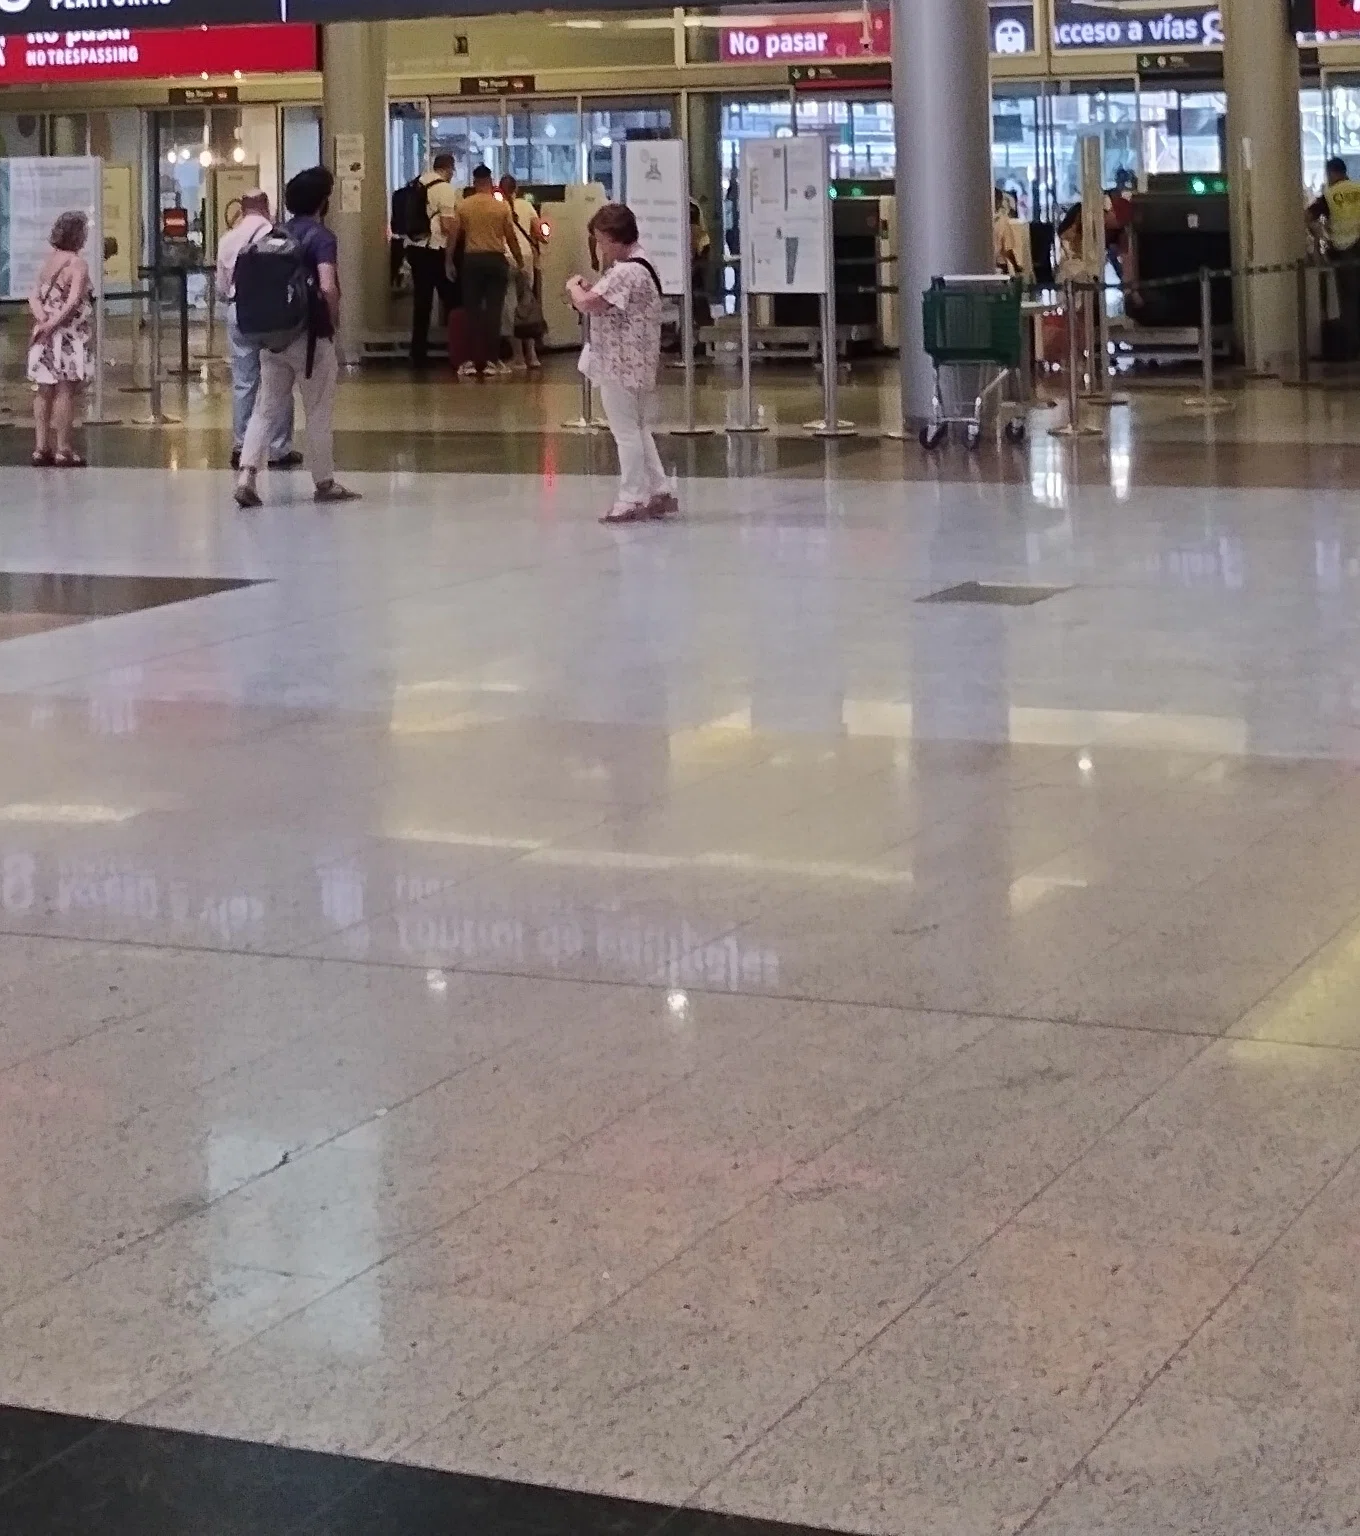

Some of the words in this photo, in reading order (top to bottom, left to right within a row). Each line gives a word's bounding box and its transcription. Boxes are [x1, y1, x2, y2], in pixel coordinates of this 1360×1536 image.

[1128, 20, 1143, 41] a
[1149, 13, 1198, 41] vías
[729, 30, 761, 55] No
[765, 30, 828, 58] pasar
